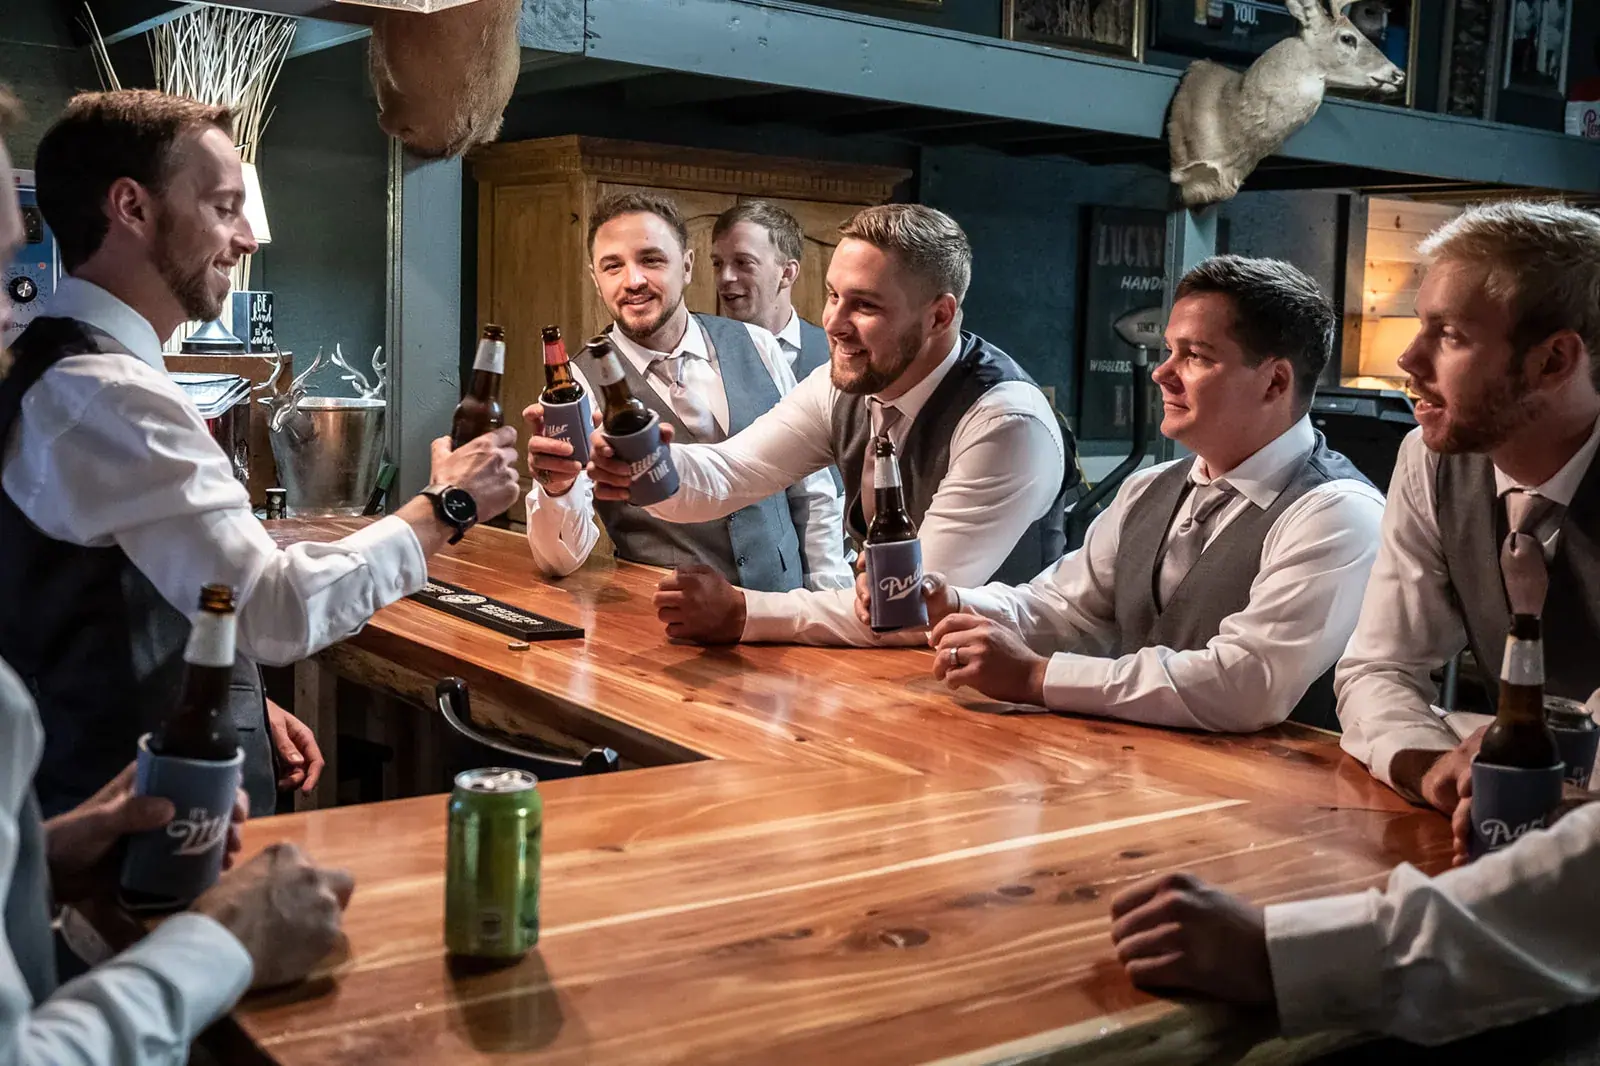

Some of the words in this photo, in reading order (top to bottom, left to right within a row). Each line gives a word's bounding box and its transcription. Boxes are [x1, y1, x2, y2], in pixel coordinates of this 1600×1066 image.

[1233, 3, 1260, 25] YOU.
[256, 294, 267, 312] BE
[647, 460, 670, 483] TIME
